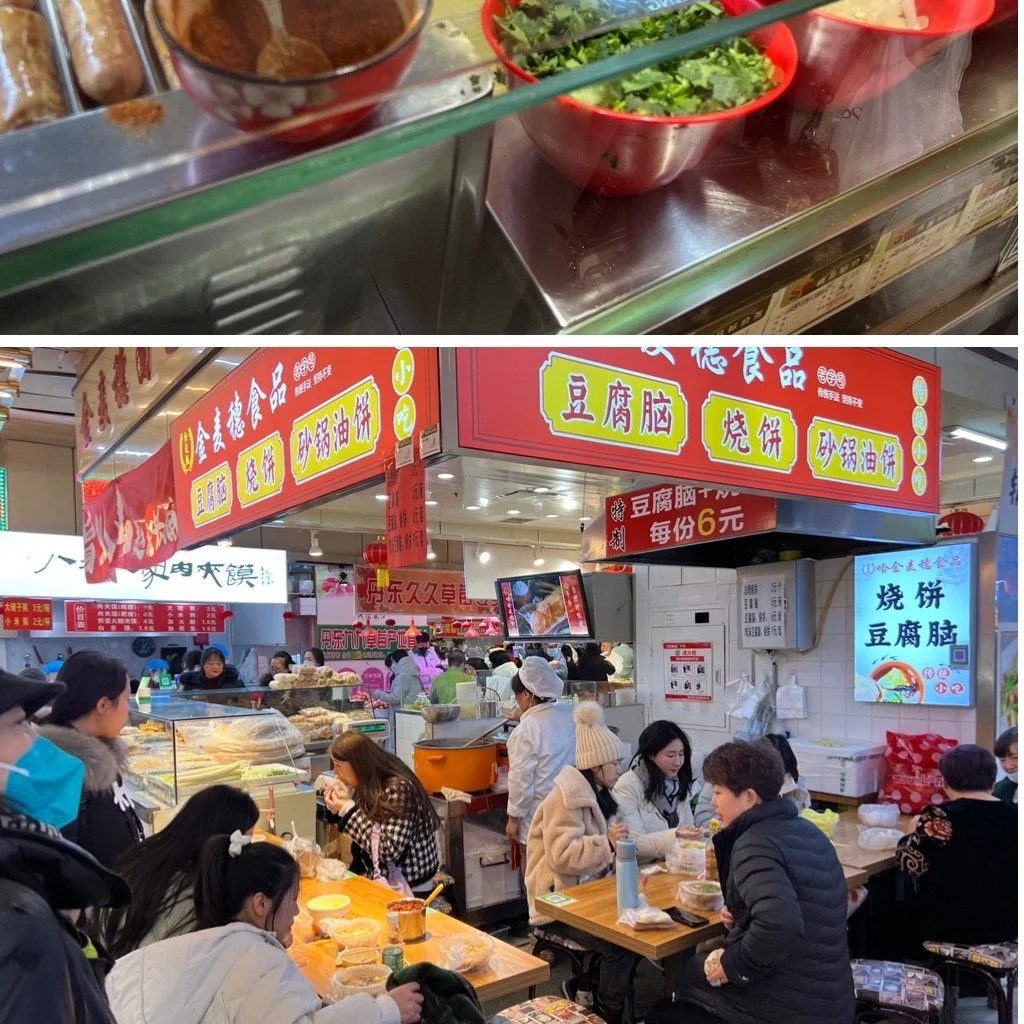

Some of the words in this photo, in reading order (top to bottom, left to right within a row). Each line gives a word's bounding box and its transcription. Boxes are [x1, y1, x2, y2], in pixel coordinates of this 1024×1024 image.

[817, 366, 846, 389] 老字号
[194, 361, 288, 464] 金麦穗食品
[562, 374, 673, 436] 豆腐脑
[296, 390, 372, 472] 砂锅油饼
[722, 410, 783, 462] 烧饼
[245, 445, 276, 494] 烧饼
[815, 429, 897, 482] 砂锅油饼
[197, 474, 228, 518] 豆腐脑
[609, 497, 627, 553] 特制
[649, 506, 745, 546] 每份6元
[876, 555, 962, 573] 哈金麦穗食品
[76, 605, 85, 629] 价目表
[875, 580, 946, 611] 烧饼
[864, 619, 958, 648] 豆腐脑
